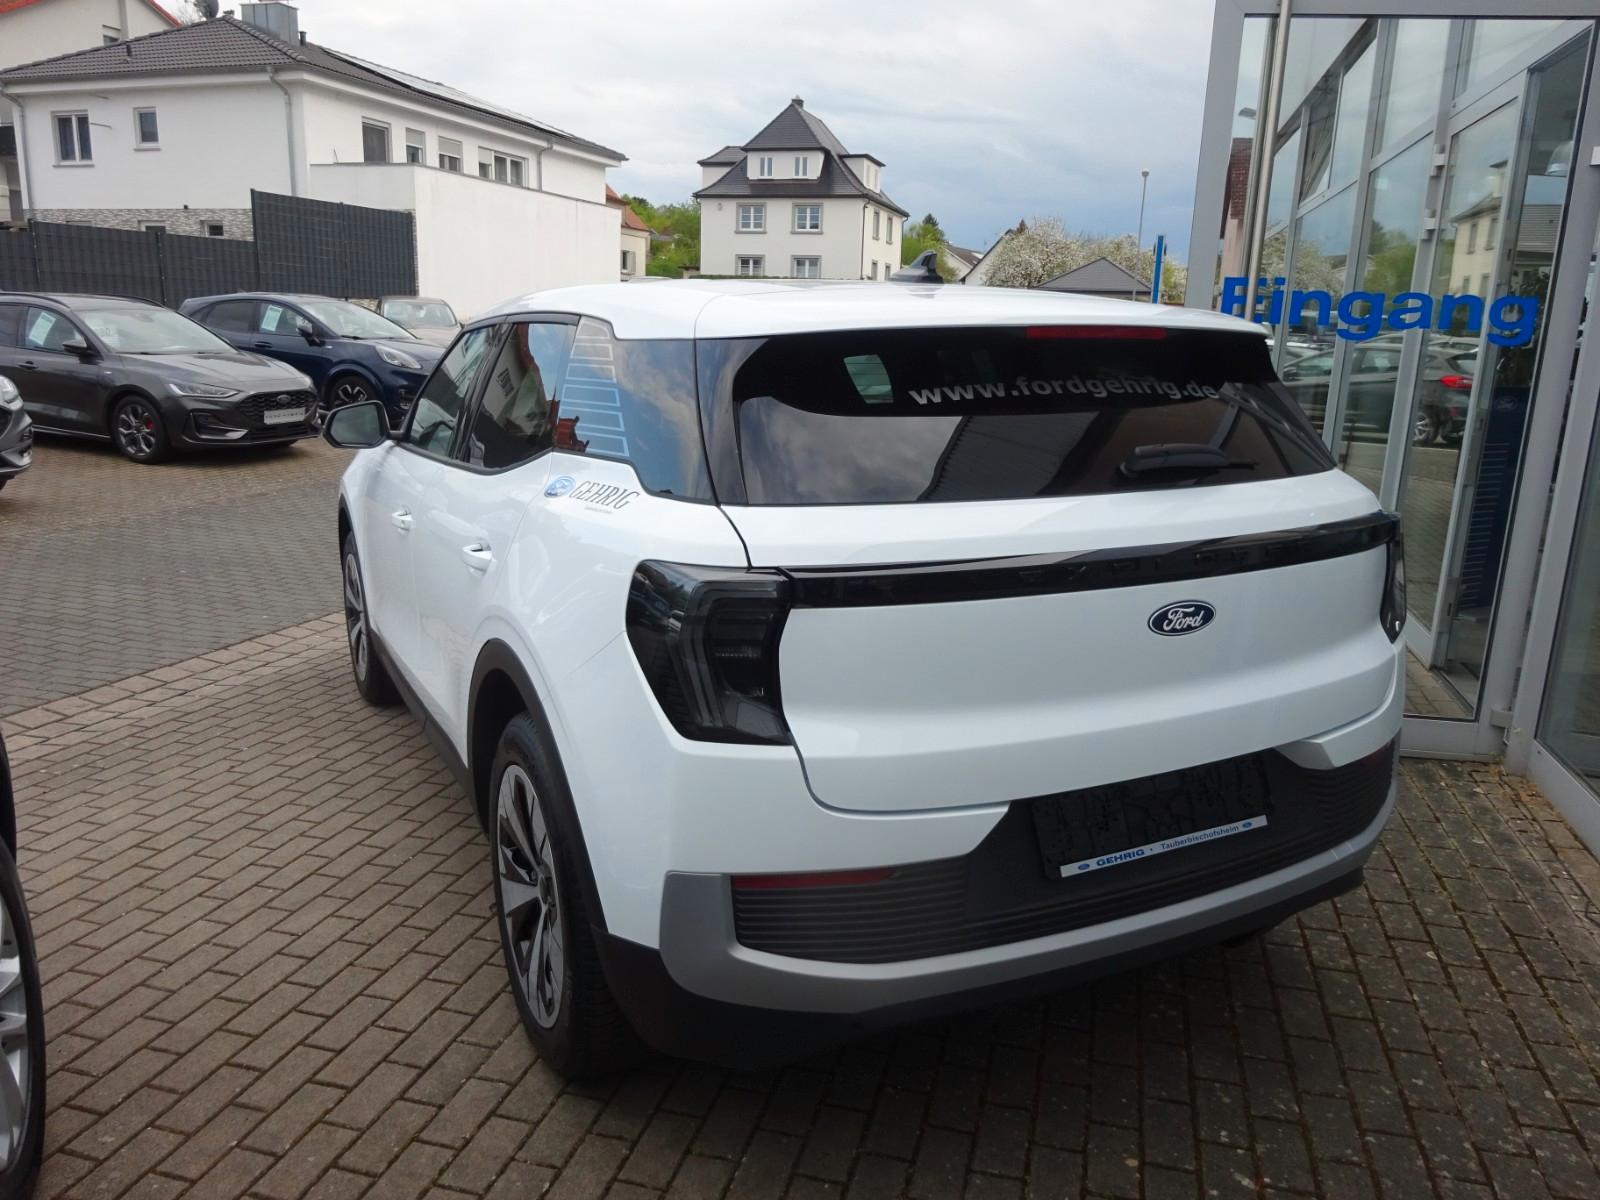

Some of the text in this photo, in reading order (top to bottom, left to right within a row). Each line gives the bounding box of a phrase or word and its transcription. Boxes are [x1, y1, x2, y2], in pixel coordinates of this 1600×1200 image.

[1221, 276, 1538, 346] Eingang
[908, 376, 1219, 404] www.fordgehrig.de
[569, 480, 640, 509] GEHRIG
[1162, 606, 1205, 631] Ford
[1096, 849, 1145, 867] GEHRIG
[1159, 825, 1240, 850] Tauberbischofsheim
